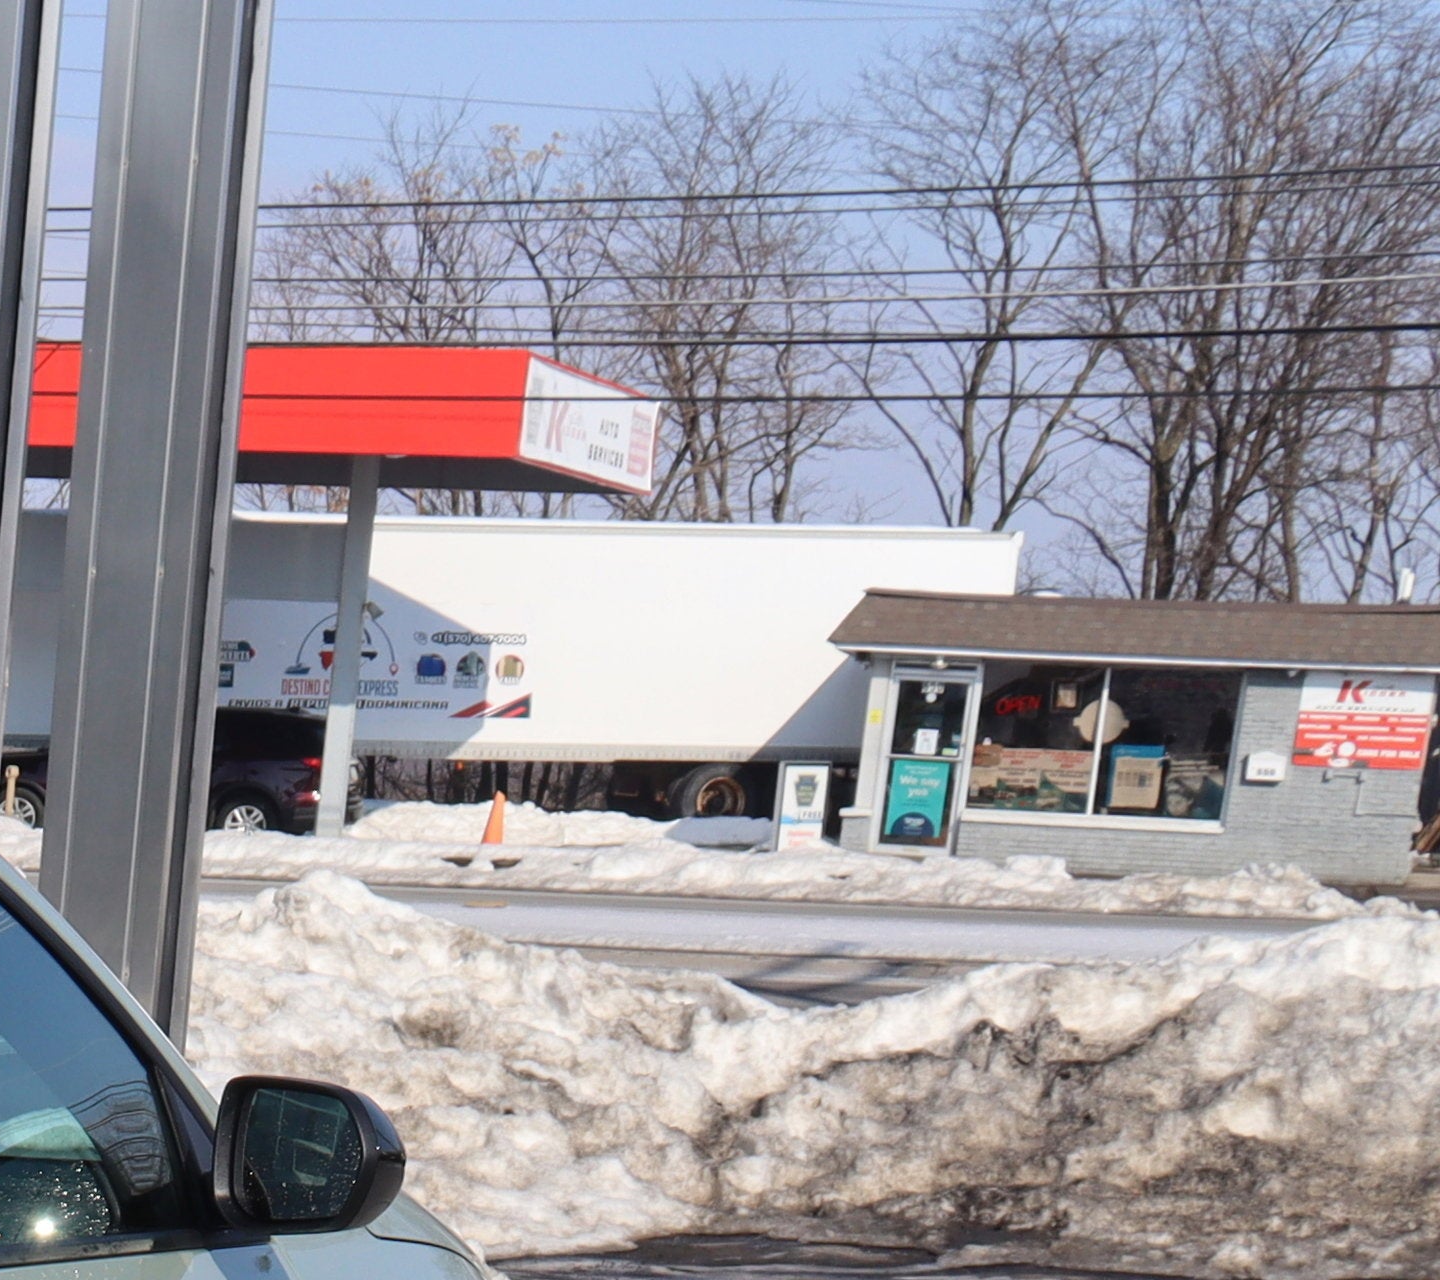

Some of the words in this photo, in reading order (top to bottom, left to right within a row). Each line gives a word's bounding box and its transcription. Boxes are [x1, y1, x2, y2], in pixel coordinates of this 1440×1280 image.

[281, 679, 321, 696] DESTINO
[358, 680, 399, 696] EXPRESS
[995, 695, 1043, 715] OPEN
